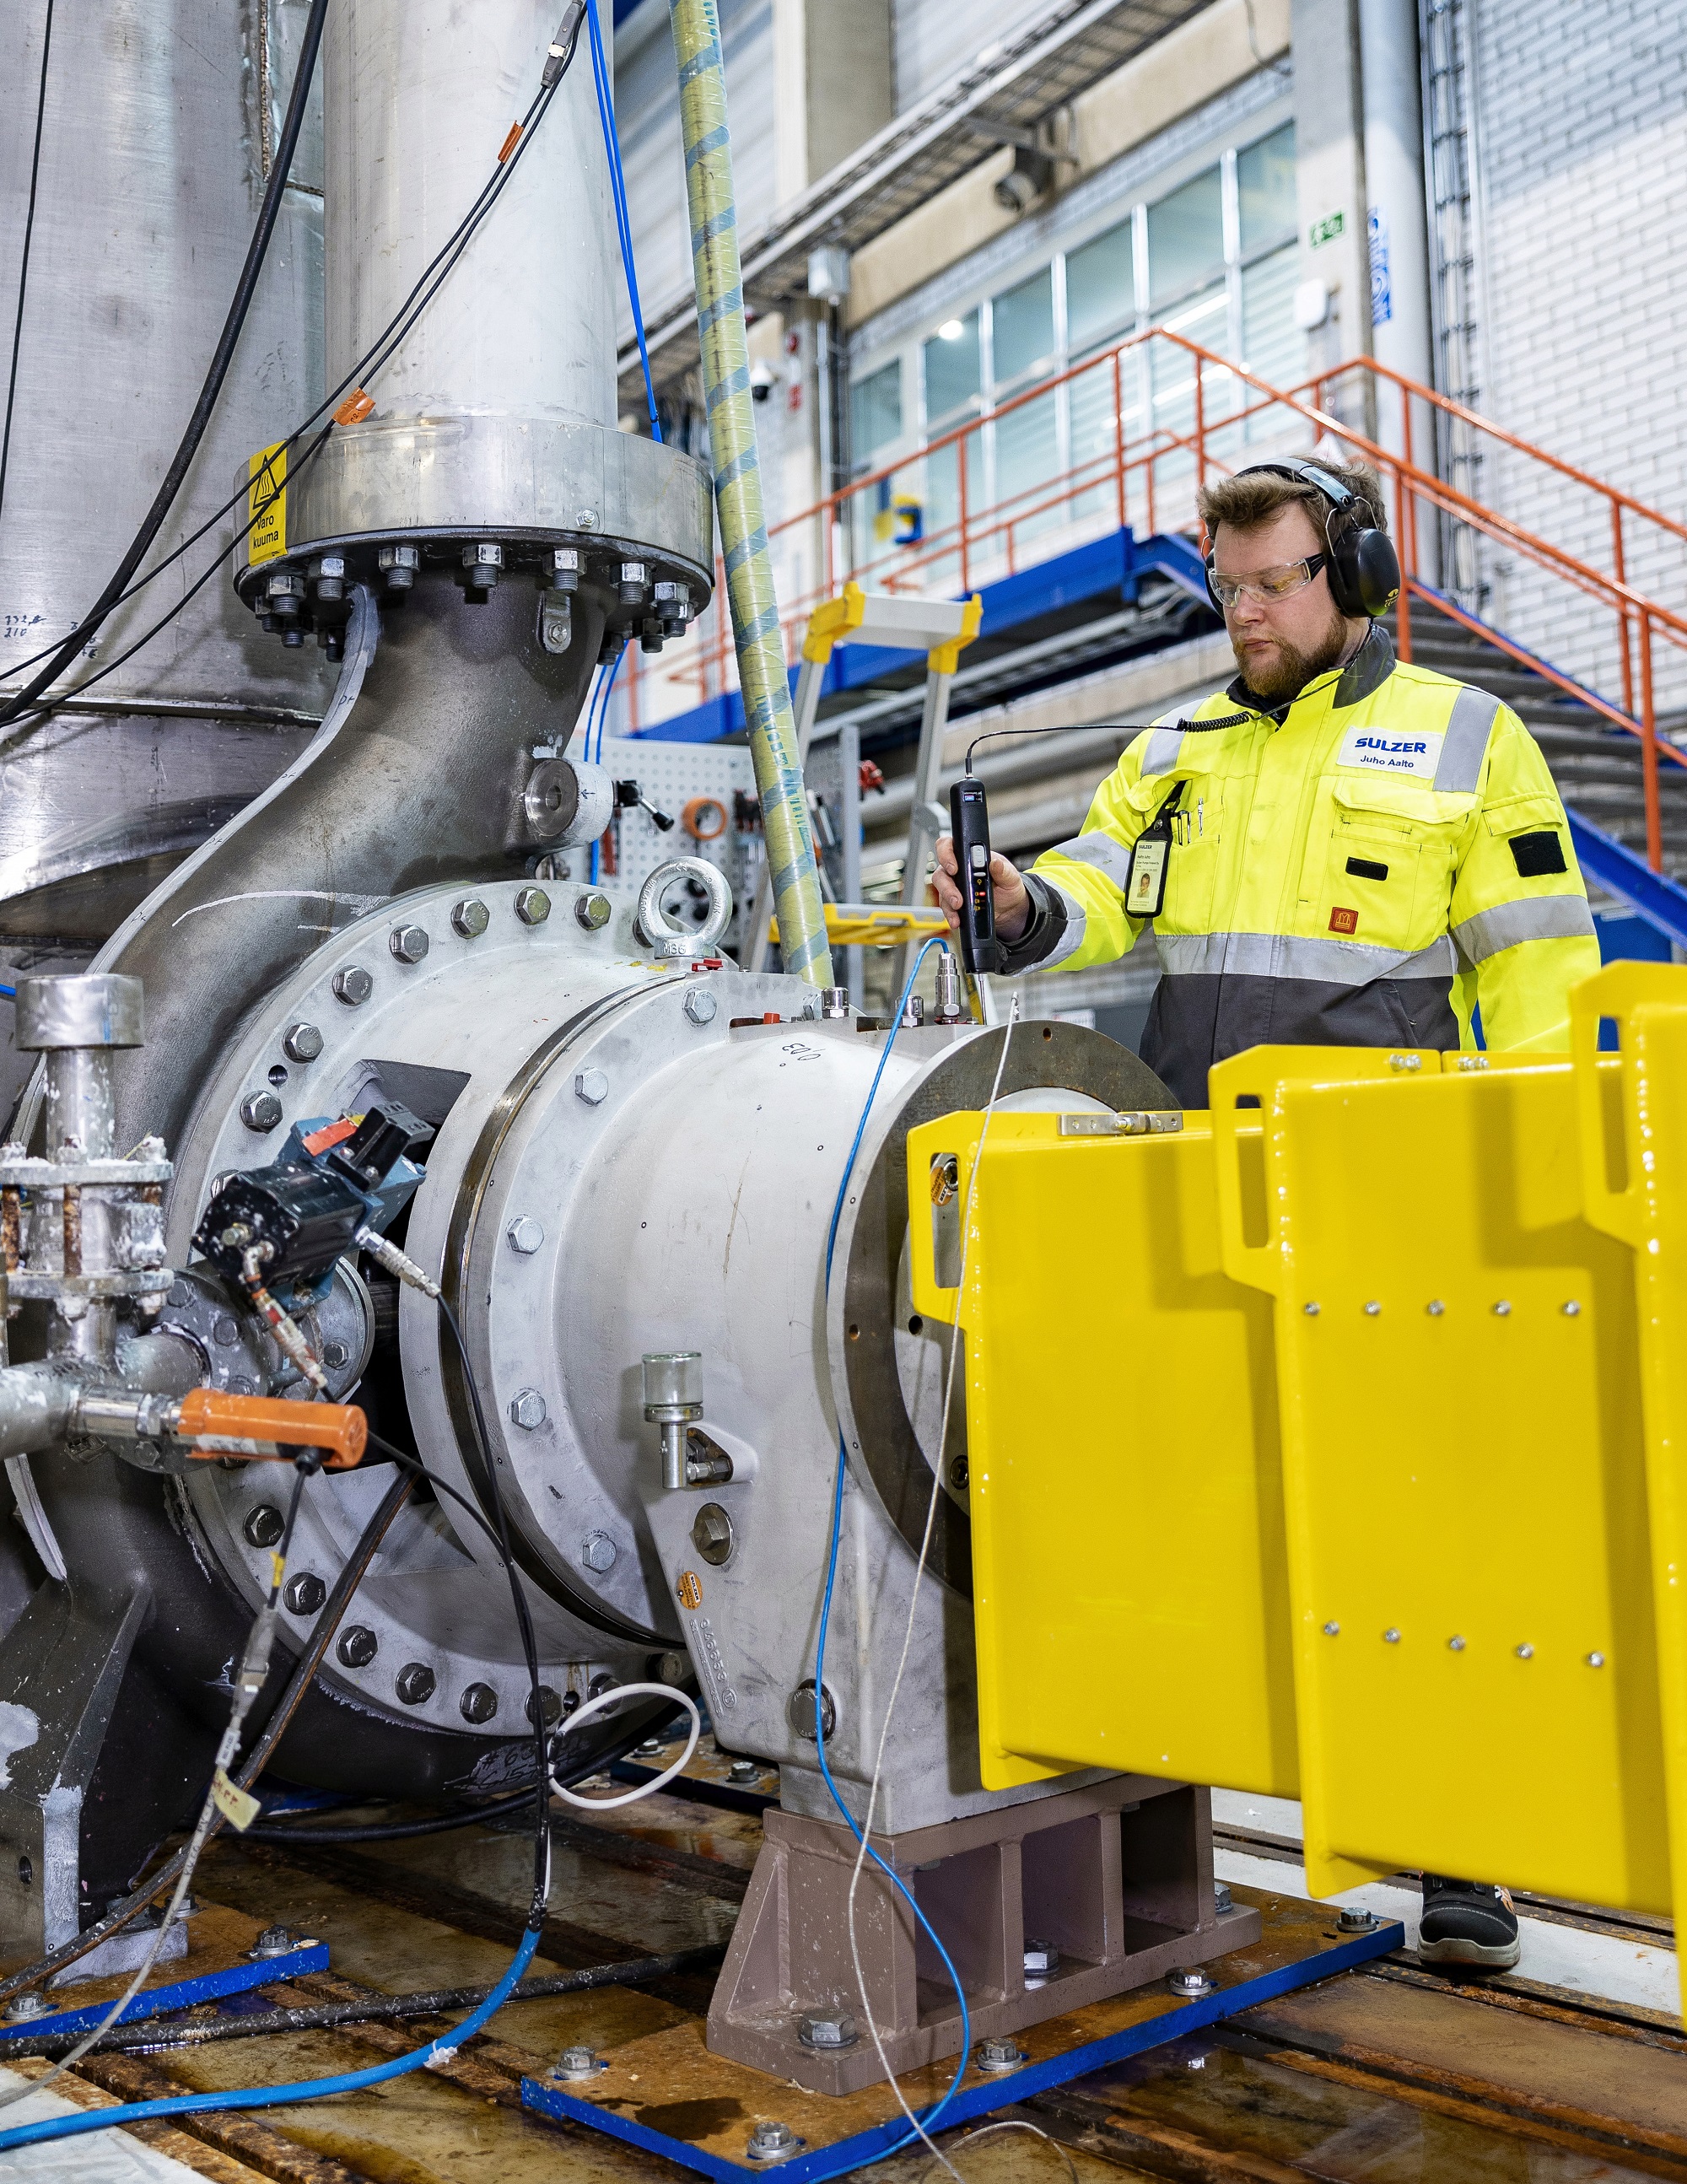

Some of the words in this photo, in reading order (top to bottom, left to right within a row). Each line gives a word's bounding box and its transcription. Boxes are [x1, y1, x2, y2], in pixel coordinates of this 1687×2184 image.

[256, 515, 275, 531] Varo
[253, 530, 279, 549] kuuma
[1355, 737, 1426, 754] SULZER
[1360, 755, 1386, 765] Juho
[1388, 759, 1415, 768] Aalto
[663, 943, 687, 955] M36
[690, 1576, 699, 1600] SULZER
